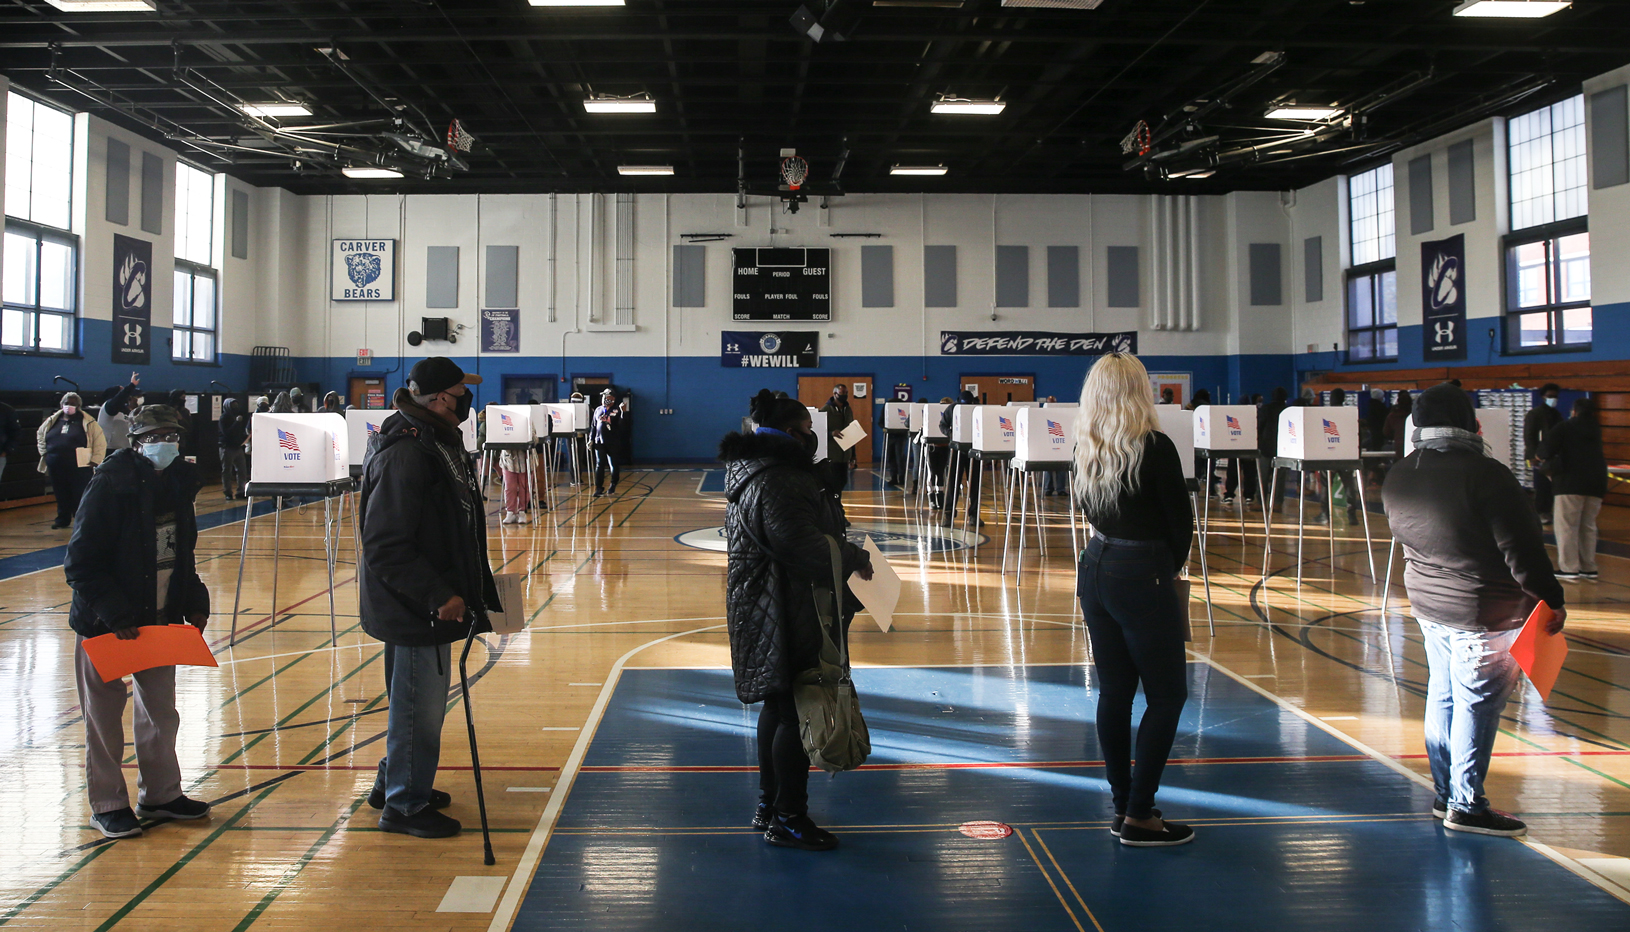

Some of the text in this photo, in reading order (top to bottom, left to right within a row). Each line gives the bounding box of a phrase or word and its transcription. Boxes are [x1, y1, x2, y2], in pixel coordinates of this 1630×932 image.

[340, 242, 386, 252] CARVER
[738, 267, 759, 276] HOME
[803, 267, 826, 276] GUEST
[344, 288, 381, 298] BEARS
[962, 335, 1107, 351] DEFEND THE DEN
[741, 355, 799, 368] #WEWILL
[284, 452, 301, 461] VOTE
